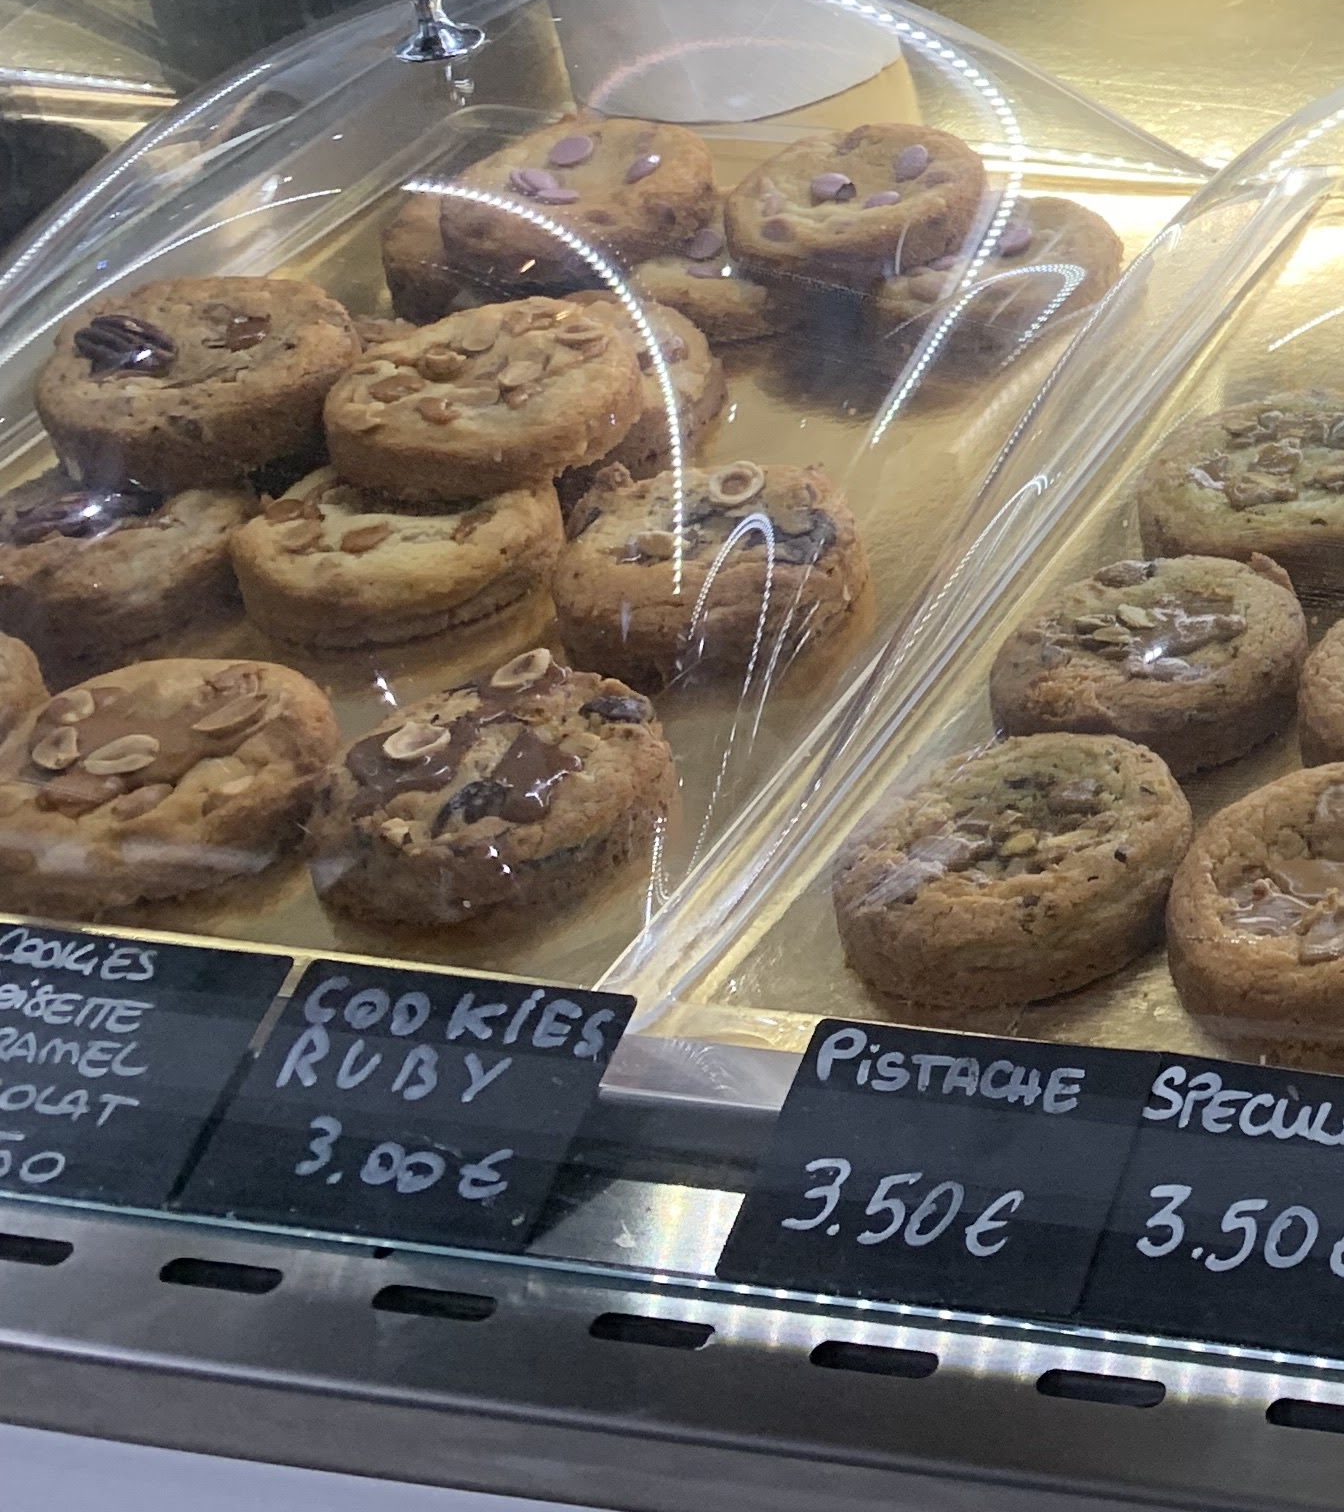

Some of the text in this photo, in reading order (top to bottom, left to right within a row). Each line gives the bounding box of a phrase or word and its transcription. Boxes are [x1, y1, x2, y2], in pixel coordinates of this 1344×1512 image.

[0, 1026, 148, 1078] RAMEL
[276, 1024, 511, 1102] RUBY
[0, 1084, 140, 1128] OLAT
